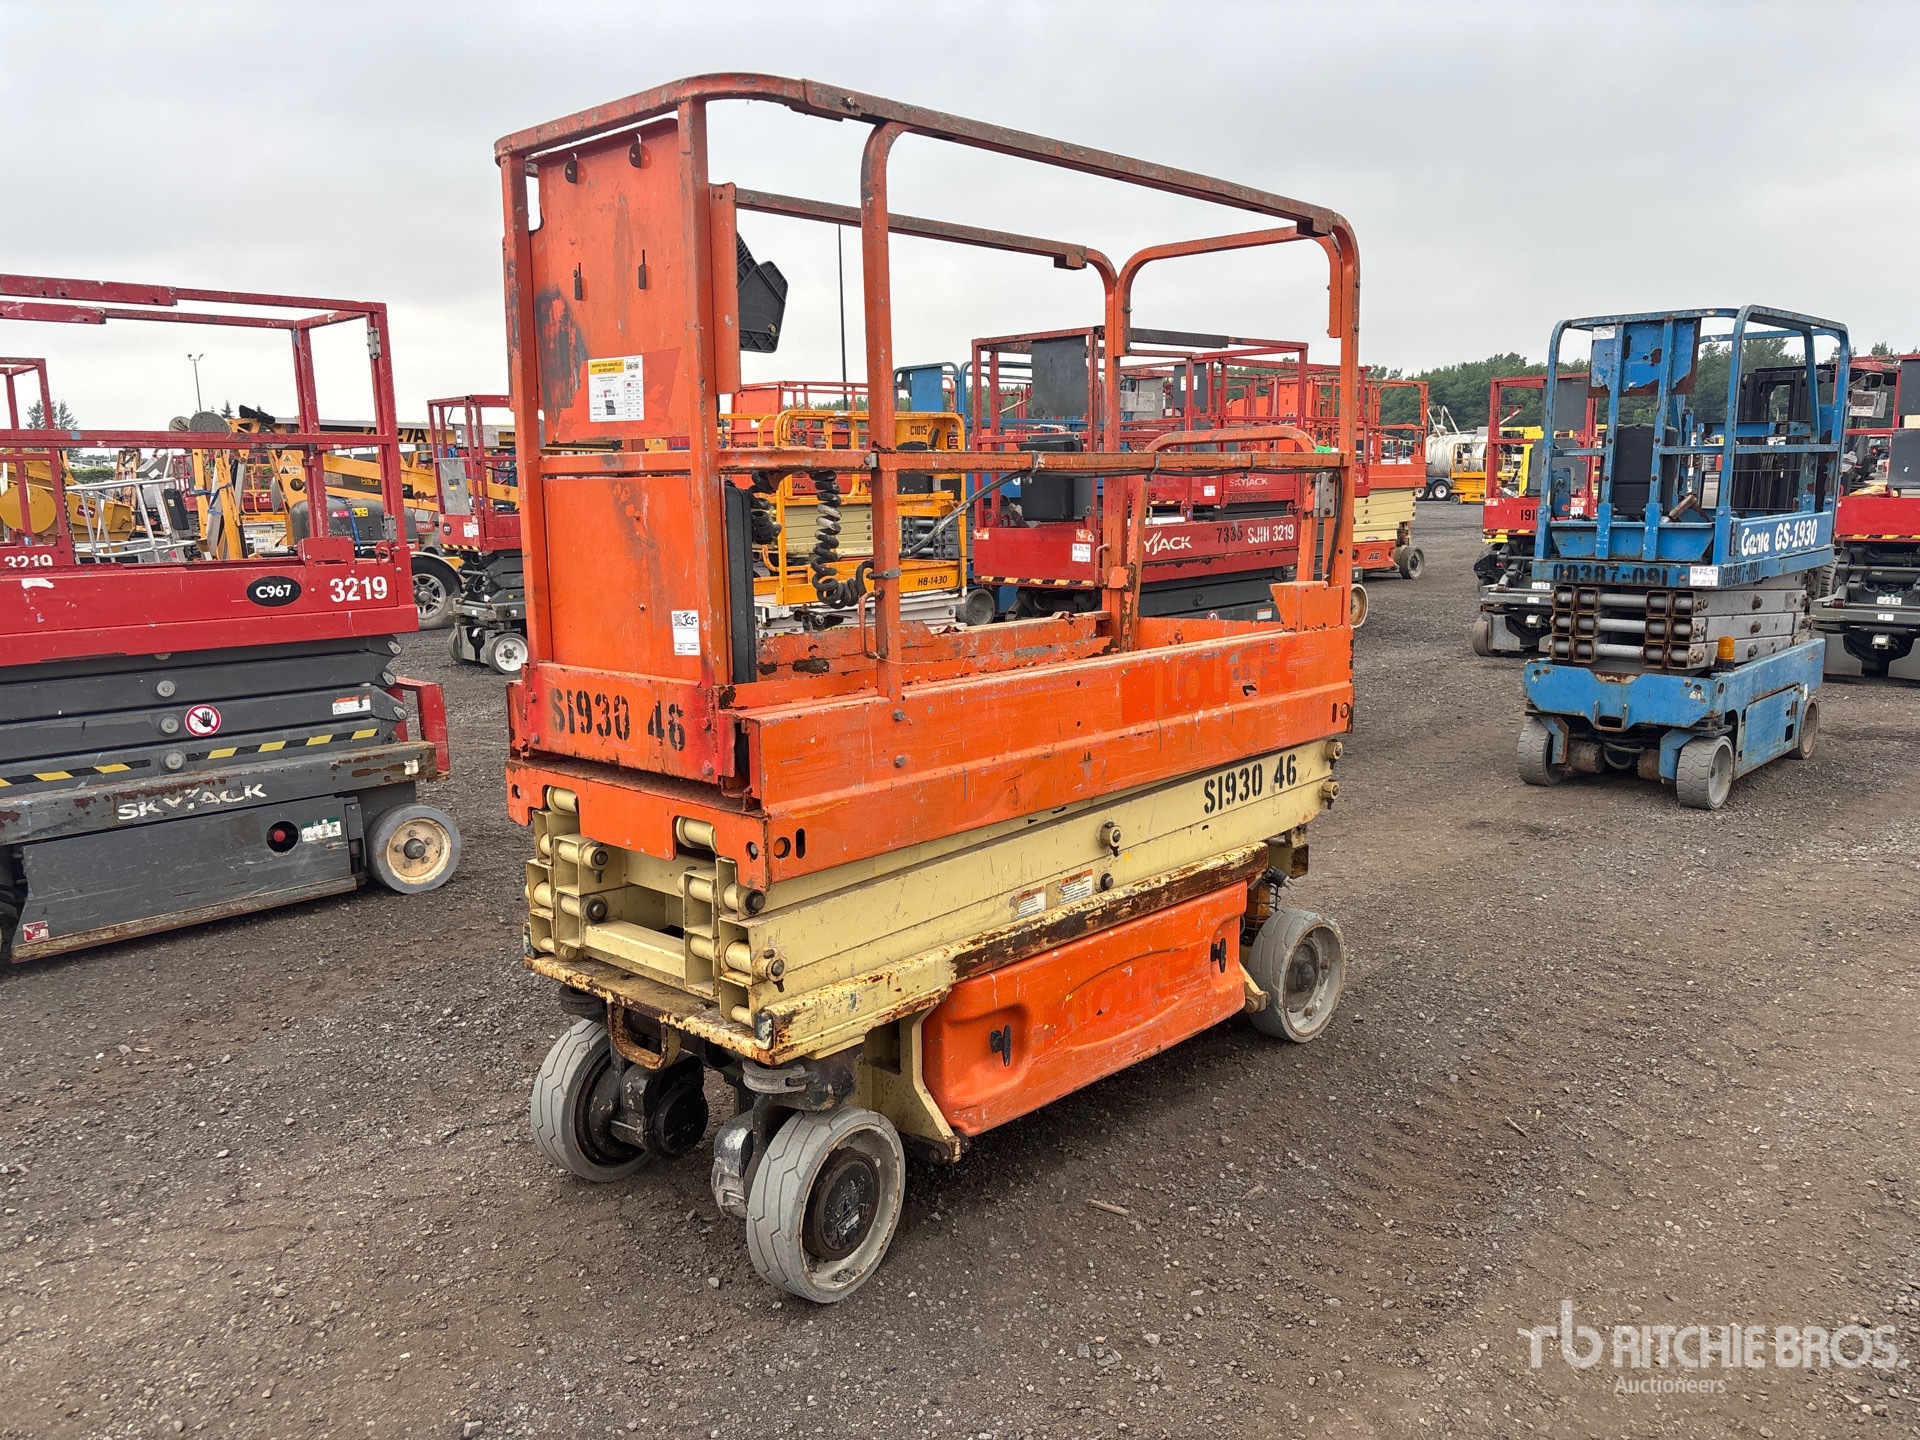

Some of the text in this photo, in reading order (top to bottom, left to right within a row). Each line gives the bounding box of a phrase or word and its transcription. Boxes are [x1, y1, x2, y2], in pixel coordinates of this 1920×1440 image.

[1229, 477, 1268, 487] SKYJACK
[1143, 530, 1193, 555] YJACK
[1272, 524, 1294, 541] 3219
[1741, 519, 1818, 556] Genie GS-1930
[4, 554, 54, 568] 3219
[329, 576, 388, 602] 3219
[917, 575, 948, 586] HB-1430
[255, 584, 292, 599] C967
[647, 700, 686, 752] 46
[1273, 753, 1297, 789] 46
